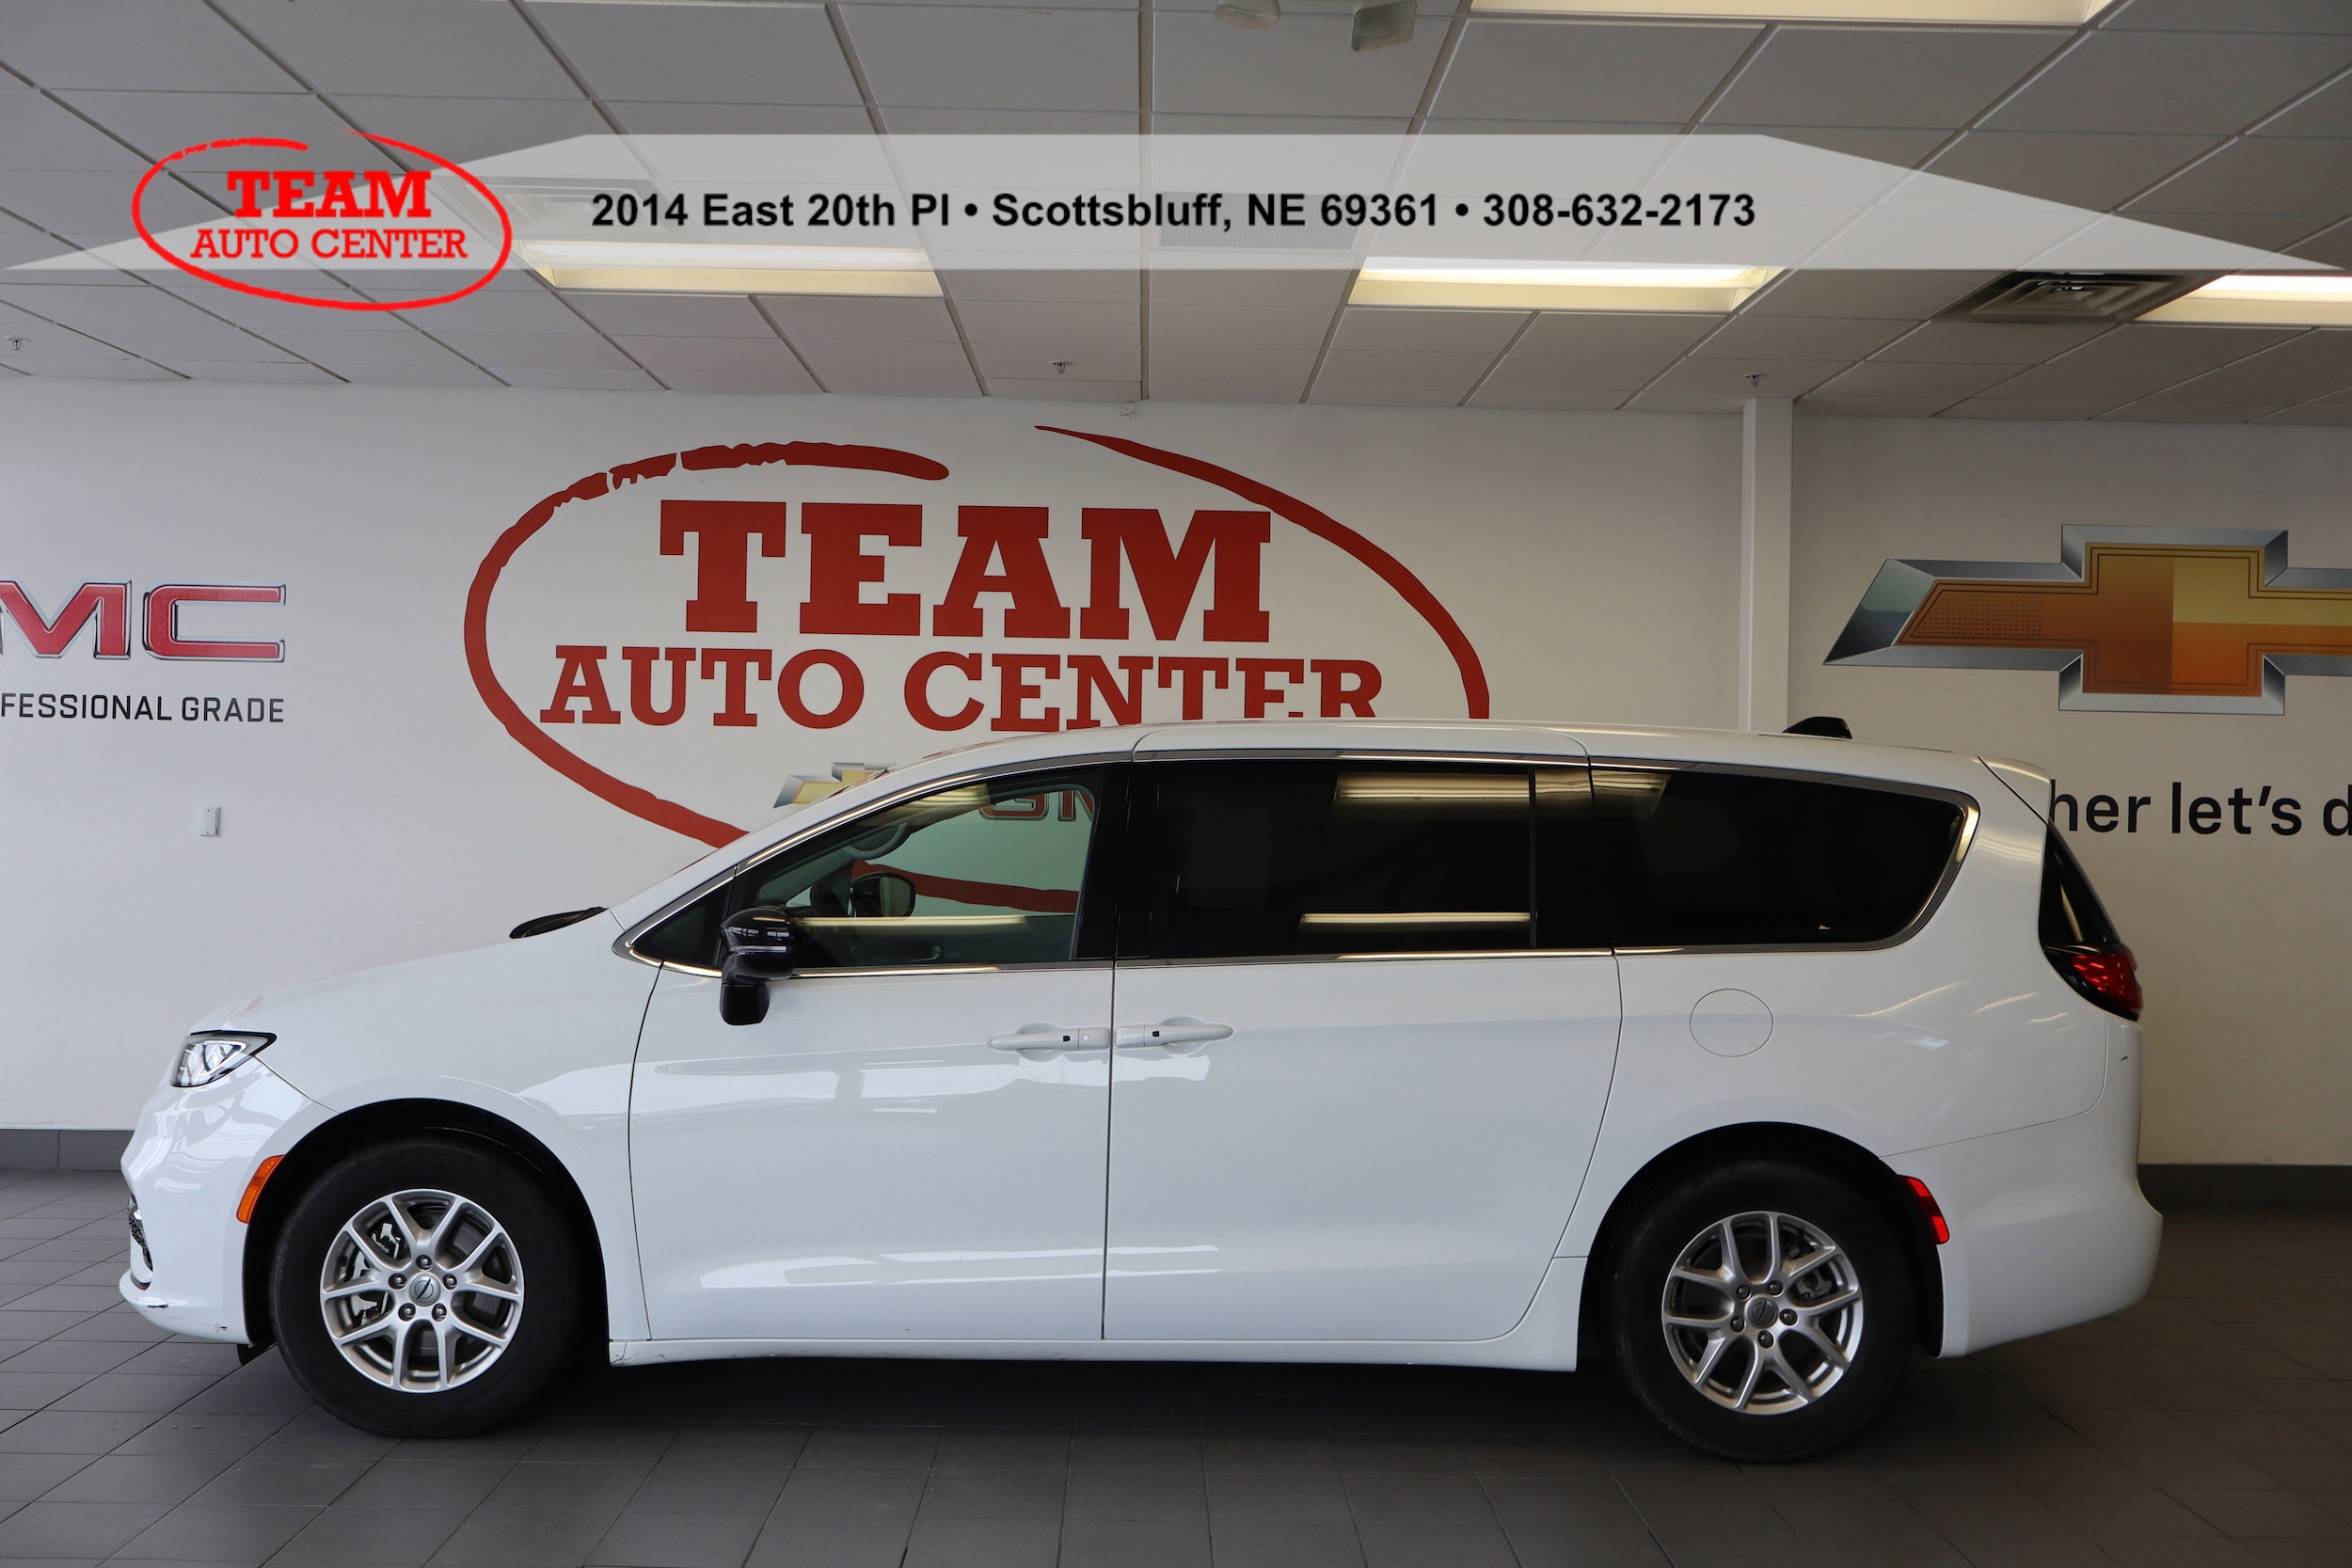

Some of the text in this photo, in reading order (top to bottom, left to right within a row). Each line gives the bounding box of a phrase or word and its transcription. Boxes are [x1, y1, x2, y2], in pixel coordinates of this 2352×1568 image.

[660, 499, 1271, 642] TEAM
[182, 696, 285, 723] GRADE
[540, 645, 1382, 733] AUTO CENTER
[2171, 782, 2302, 836] let's
